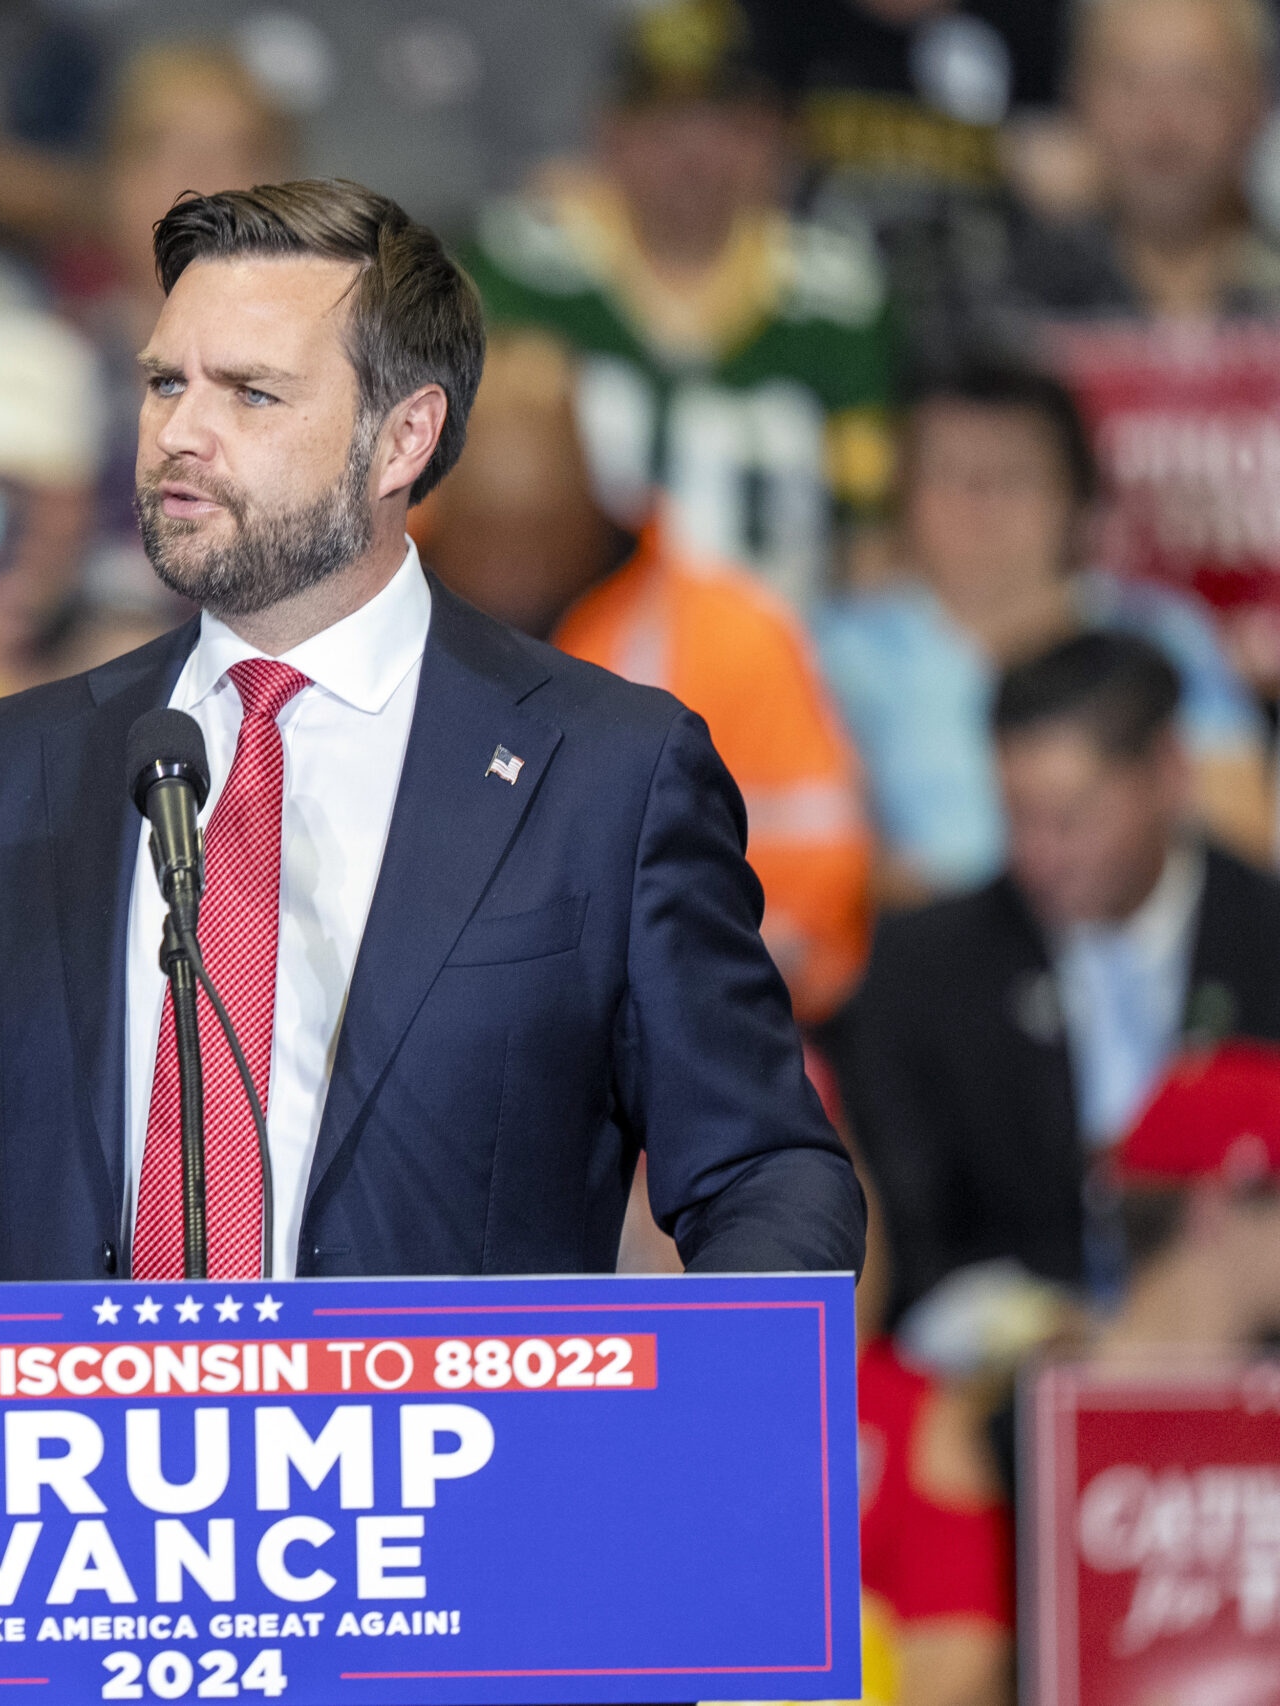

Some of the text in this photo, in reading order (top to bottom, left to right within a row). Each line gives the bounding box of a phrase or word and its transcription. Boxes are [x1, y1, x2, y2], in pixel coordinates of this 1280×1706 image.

[326, 1340, 414, 1391] TO
[432, 1337, 634, 1390] 88022
[35, 1614, 199, 1642] AMERICA
[208, 1612, 326, 1640] GREAT
[335, 1609, 461, 1638] AGAIN!
[101, 1648, 288, 1701] 2024
